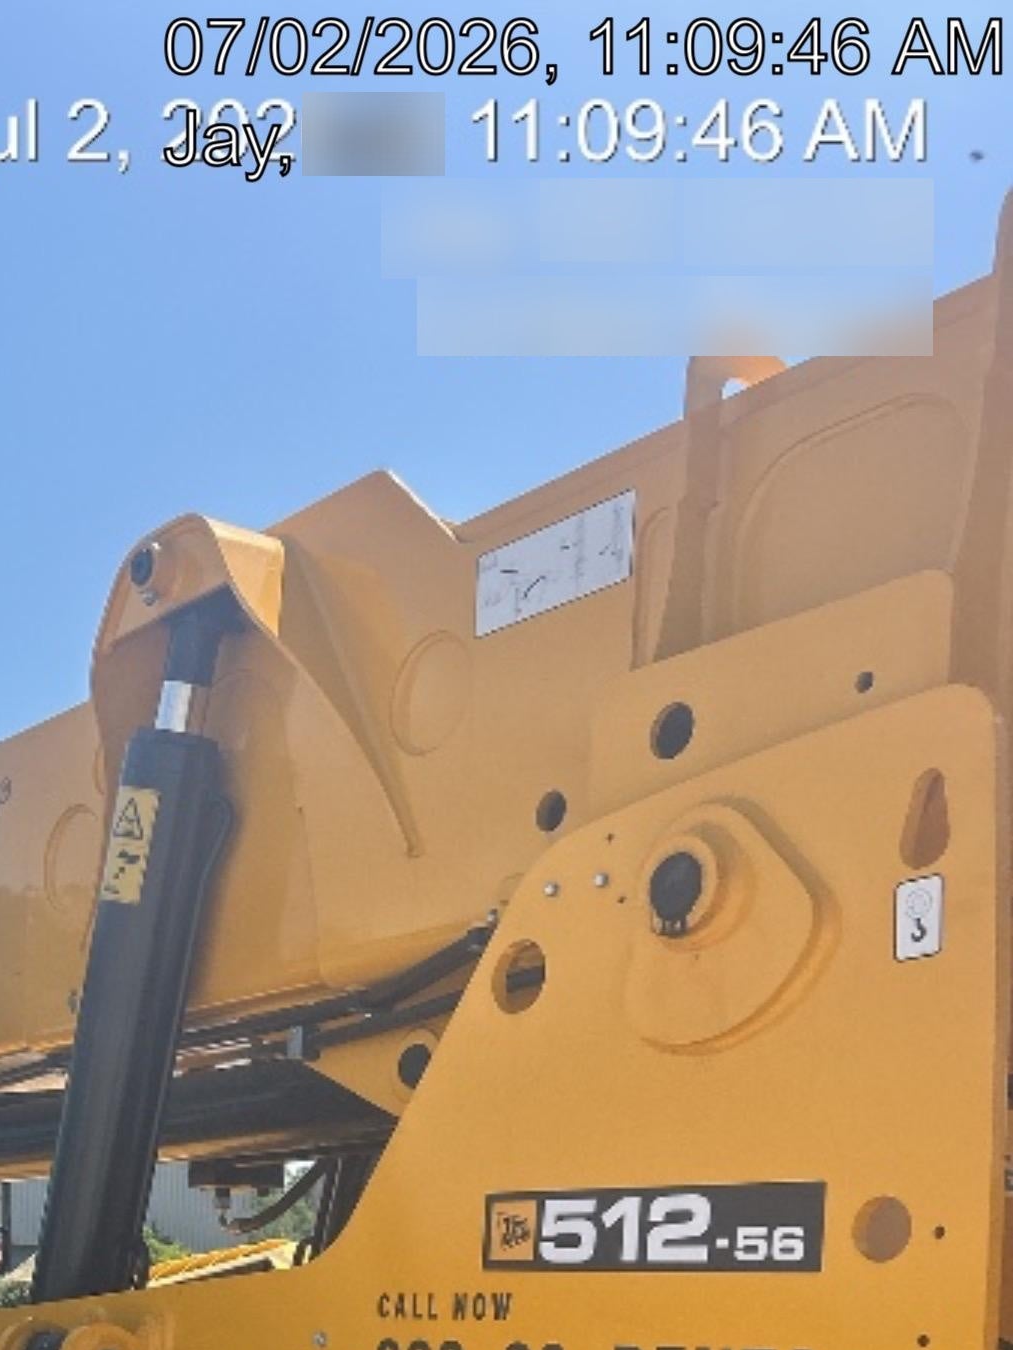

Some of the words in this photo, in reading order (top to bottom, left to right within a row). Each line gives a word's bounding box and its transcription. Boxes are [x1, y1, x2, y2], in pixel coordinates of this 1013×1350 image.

[539, 1194, 805, 1264] 512-56
[377, 1291, 438, 1319] CALL
[452, 1292, 512, 1321] NOW
